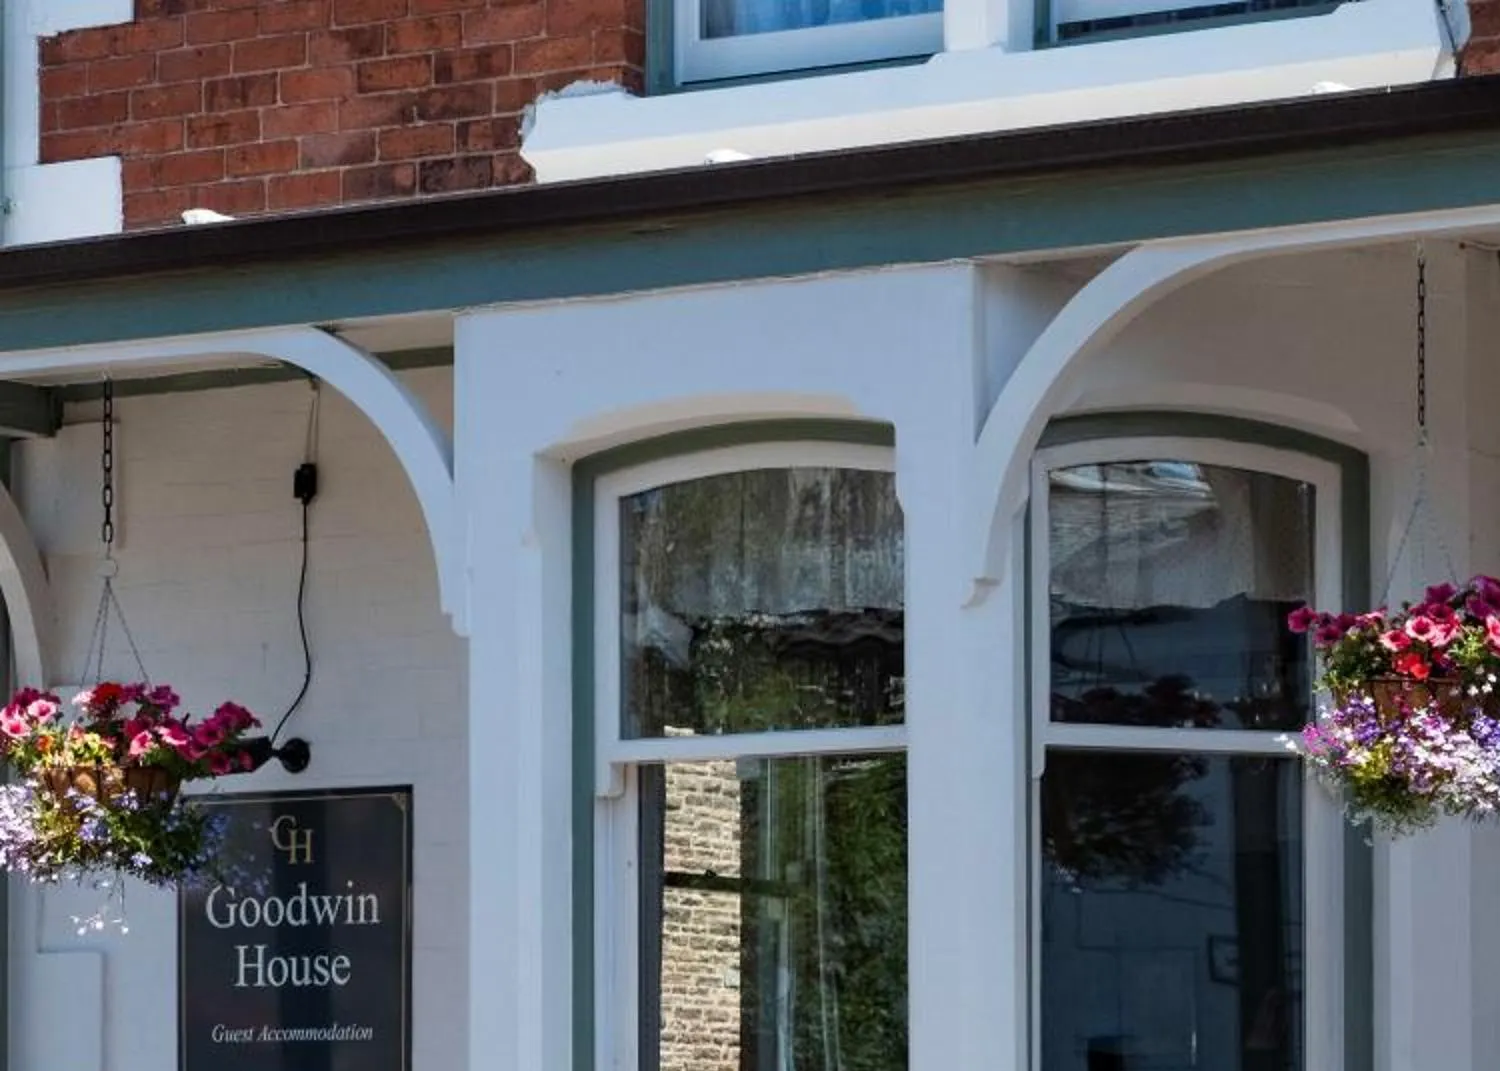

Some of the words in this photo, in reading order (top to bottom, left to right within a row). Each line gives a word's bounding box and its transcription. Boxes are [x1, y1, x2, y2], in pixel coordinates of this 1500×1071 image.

[205, 880, 380, 929] Goodwin
[234, 944, 351, 988] House
[211, 1023, 254, 1043] Guest
[256, 1023, 373, 1043] Accommodation
